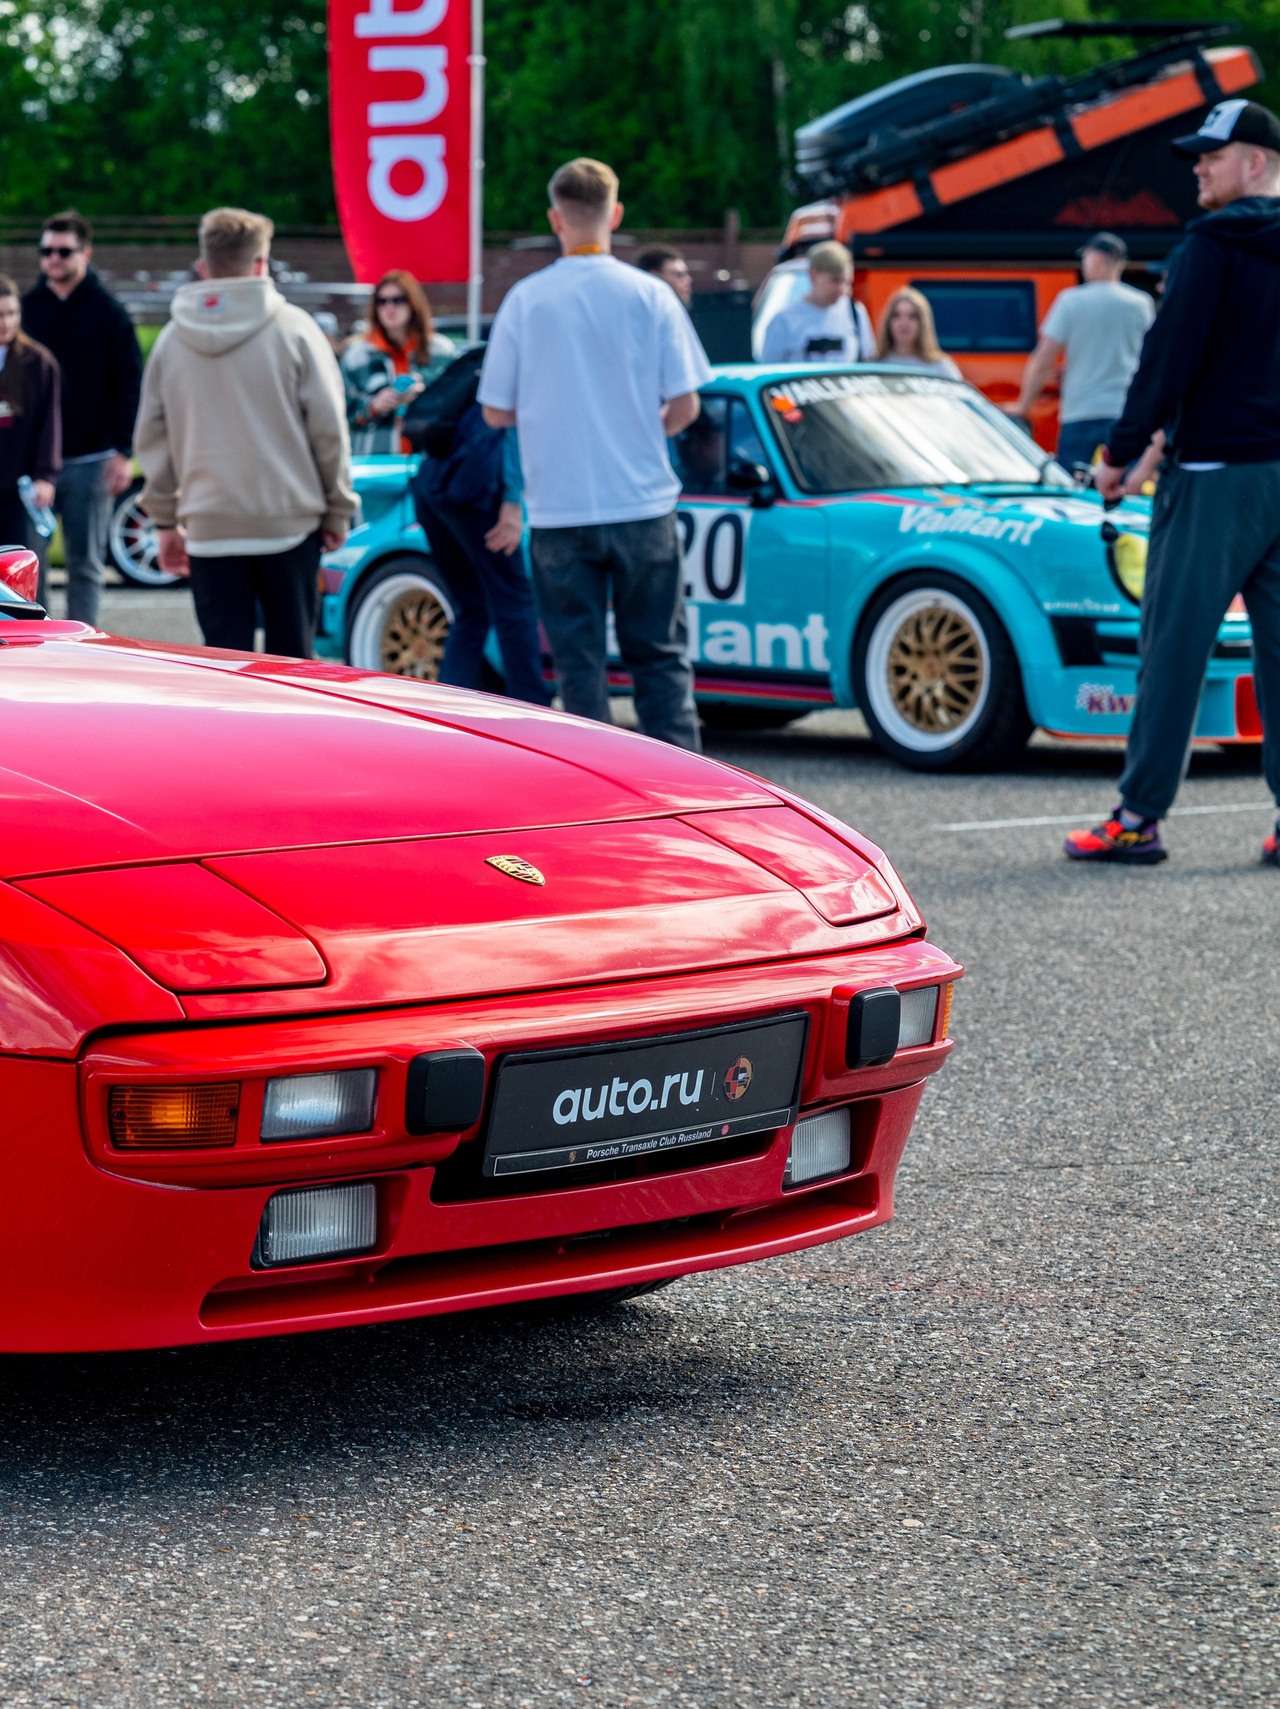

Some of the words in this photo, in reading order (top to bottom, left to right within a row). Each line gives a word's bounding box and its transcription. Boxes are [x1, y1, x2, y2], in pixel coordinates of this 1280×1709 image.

[899, 504, 1045, 546] Vaillant
[684, 605, 831, 672] lant
[553, 1069, 704, 1125] auto.ru
[586, 1146, 619, 1159] Porsche
[621, 1139, 658, 1153] Transaxle
[659, 1134, 677, 1147] Club
[678, 1128, 712, 1144] Russland
